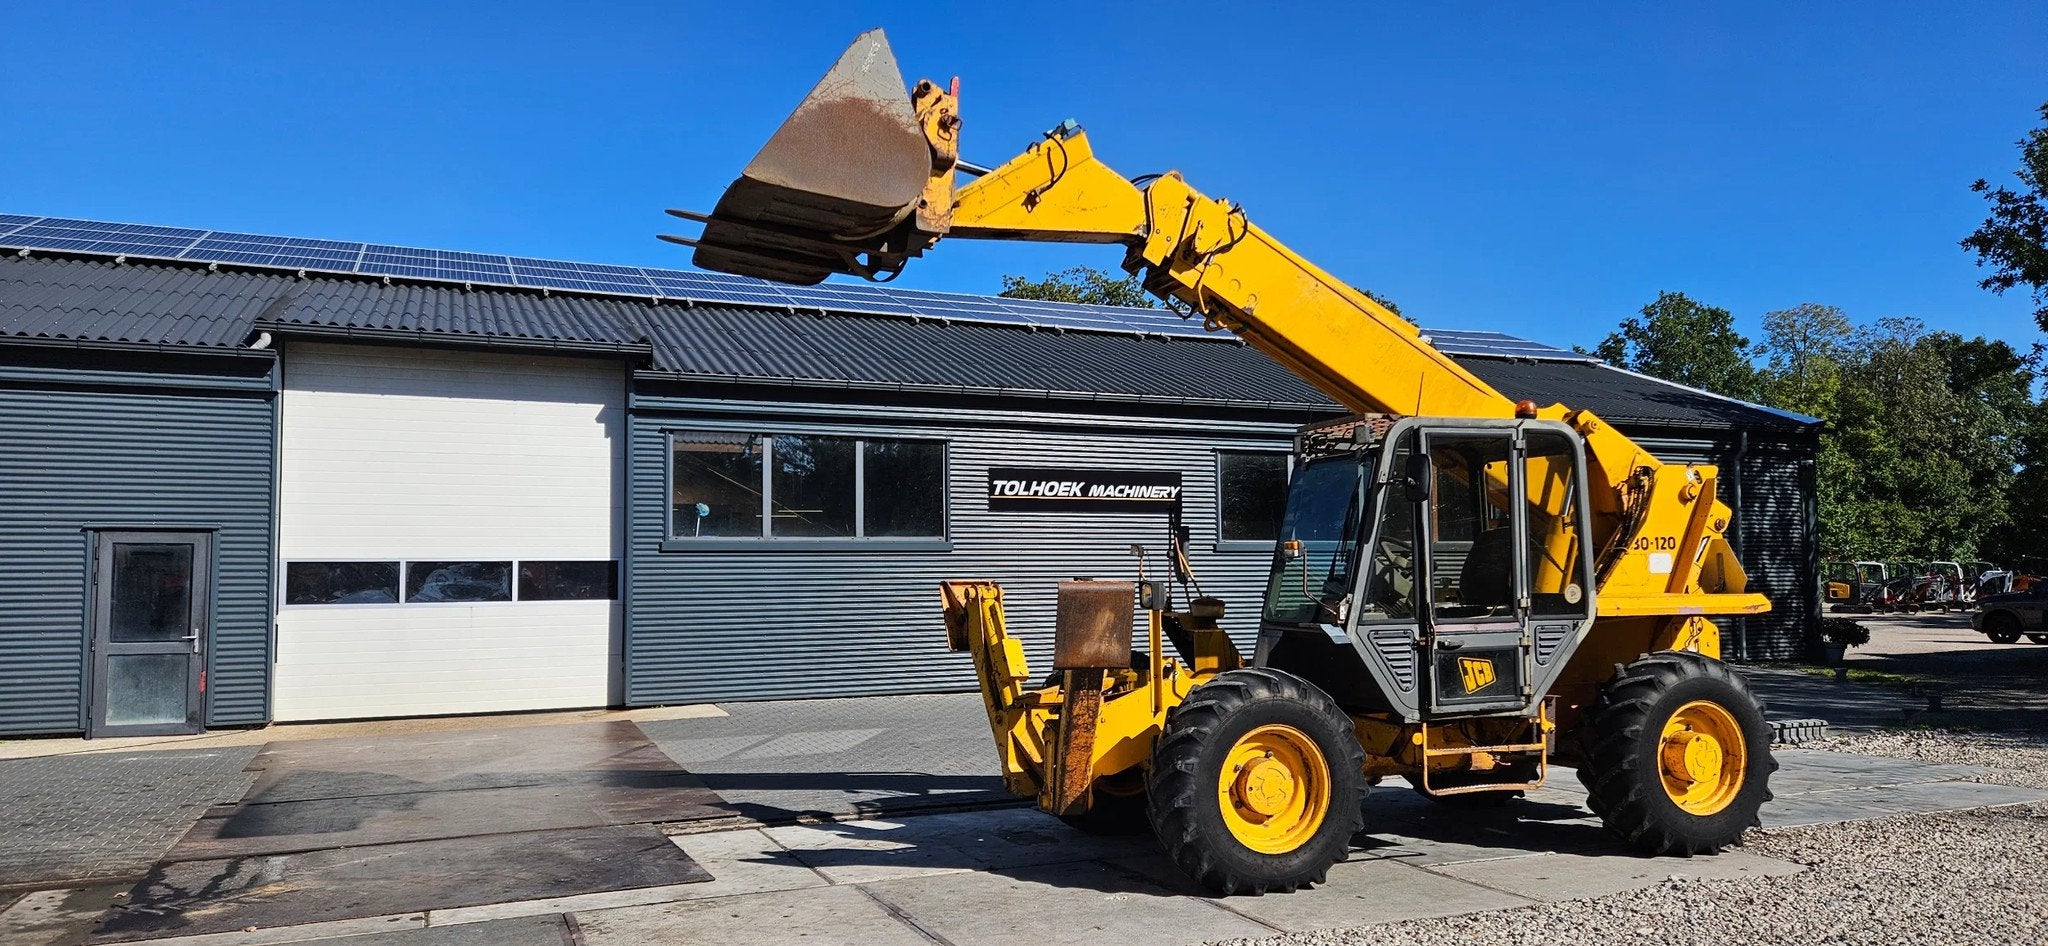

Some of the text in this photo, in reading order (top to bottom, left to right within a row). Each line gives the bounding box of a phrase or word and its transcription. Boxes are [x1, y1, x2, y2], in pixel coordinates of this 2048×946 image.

[992, 480, 1180, 498] TOLHOEK MACHINERY
[1631, 536, 1676, 550] 30-120
[1462, 660, 1495, 692] JCB
